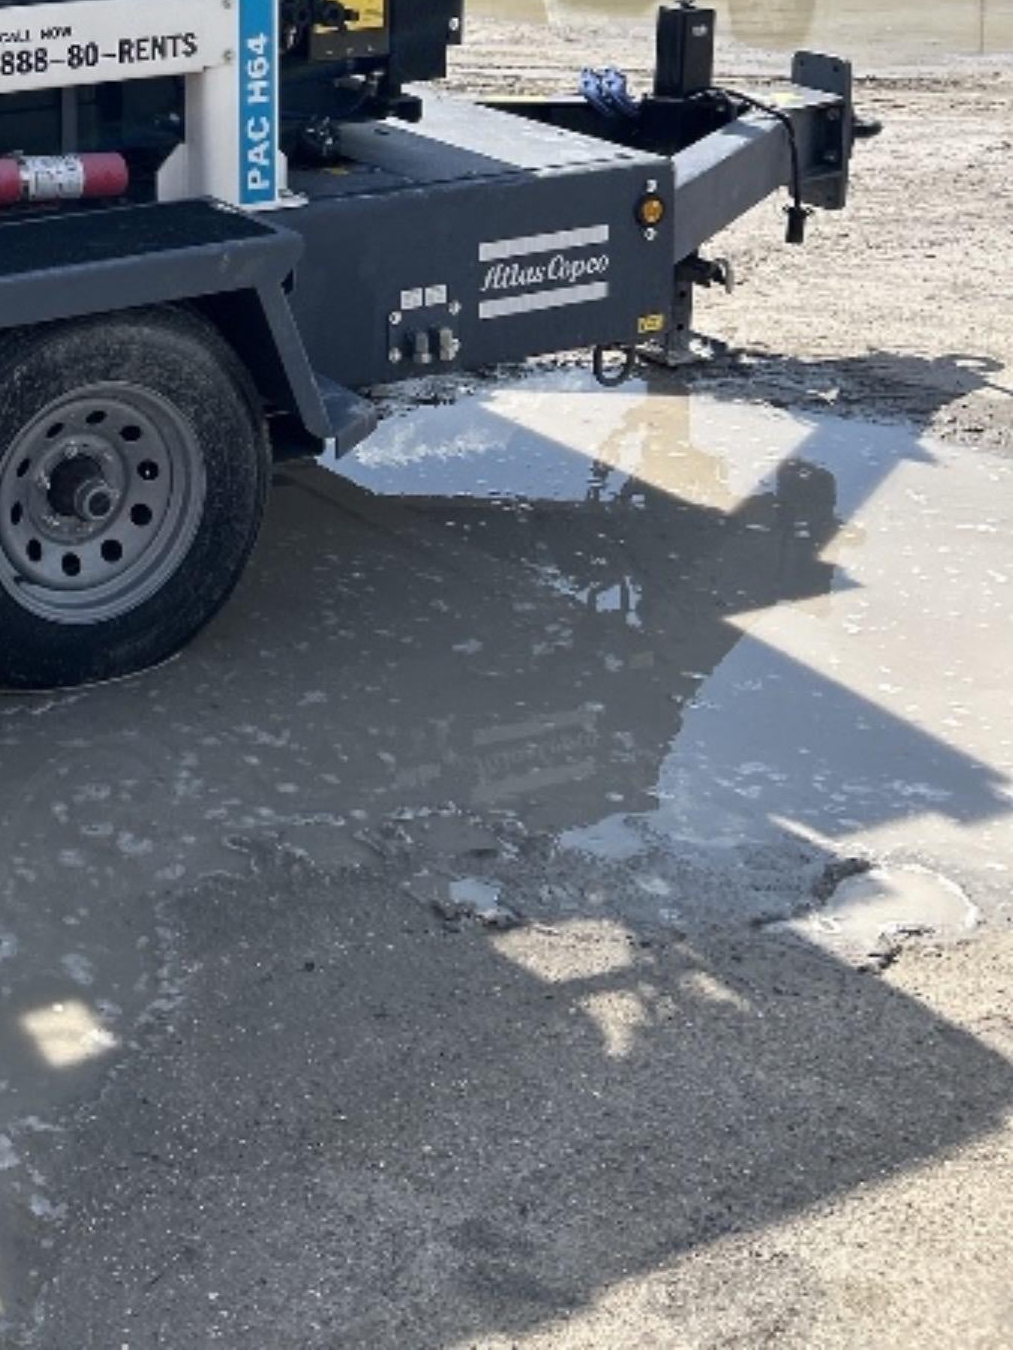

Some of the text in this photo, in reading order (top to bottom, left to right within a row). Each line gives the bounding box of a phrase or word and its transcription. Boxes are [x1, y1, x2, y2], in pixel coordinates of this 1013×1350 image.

[0, 32, 198, 76] 888-80-RENTS
[246, 32, 270, 191] PAC H64
[479, 253, 609, 292] Atlas Copco
